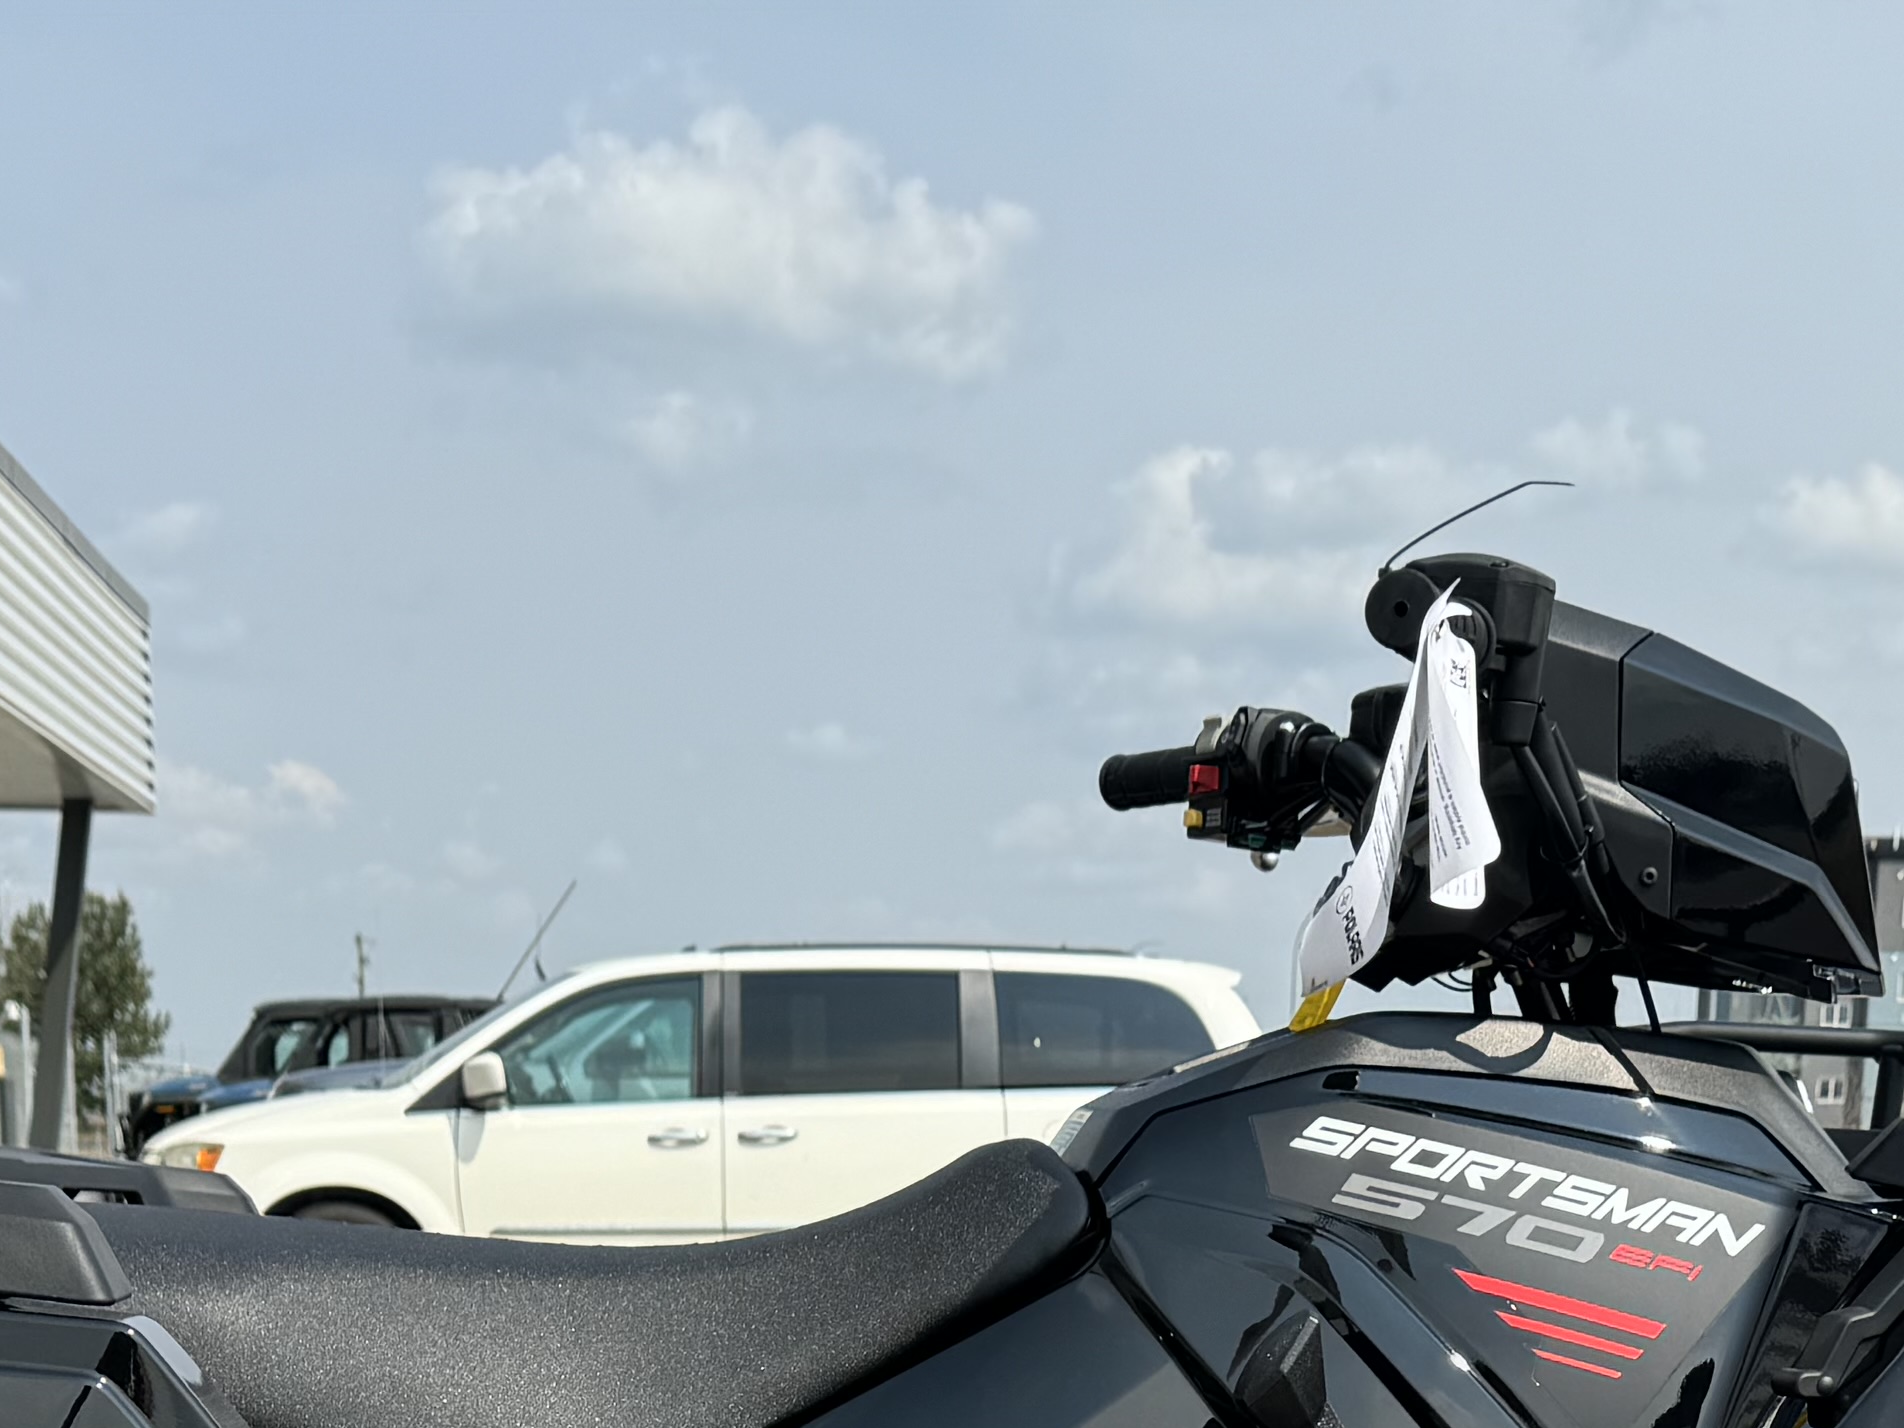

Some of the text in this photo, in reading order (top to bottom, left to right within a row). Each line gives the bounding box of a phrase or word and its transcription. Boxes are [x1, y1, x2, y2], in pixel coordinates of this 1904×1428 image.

[1289, 1116, 1766, 1257] SPORTSMAN
[1331, 1173, 1704, 1281] 570 EFI
